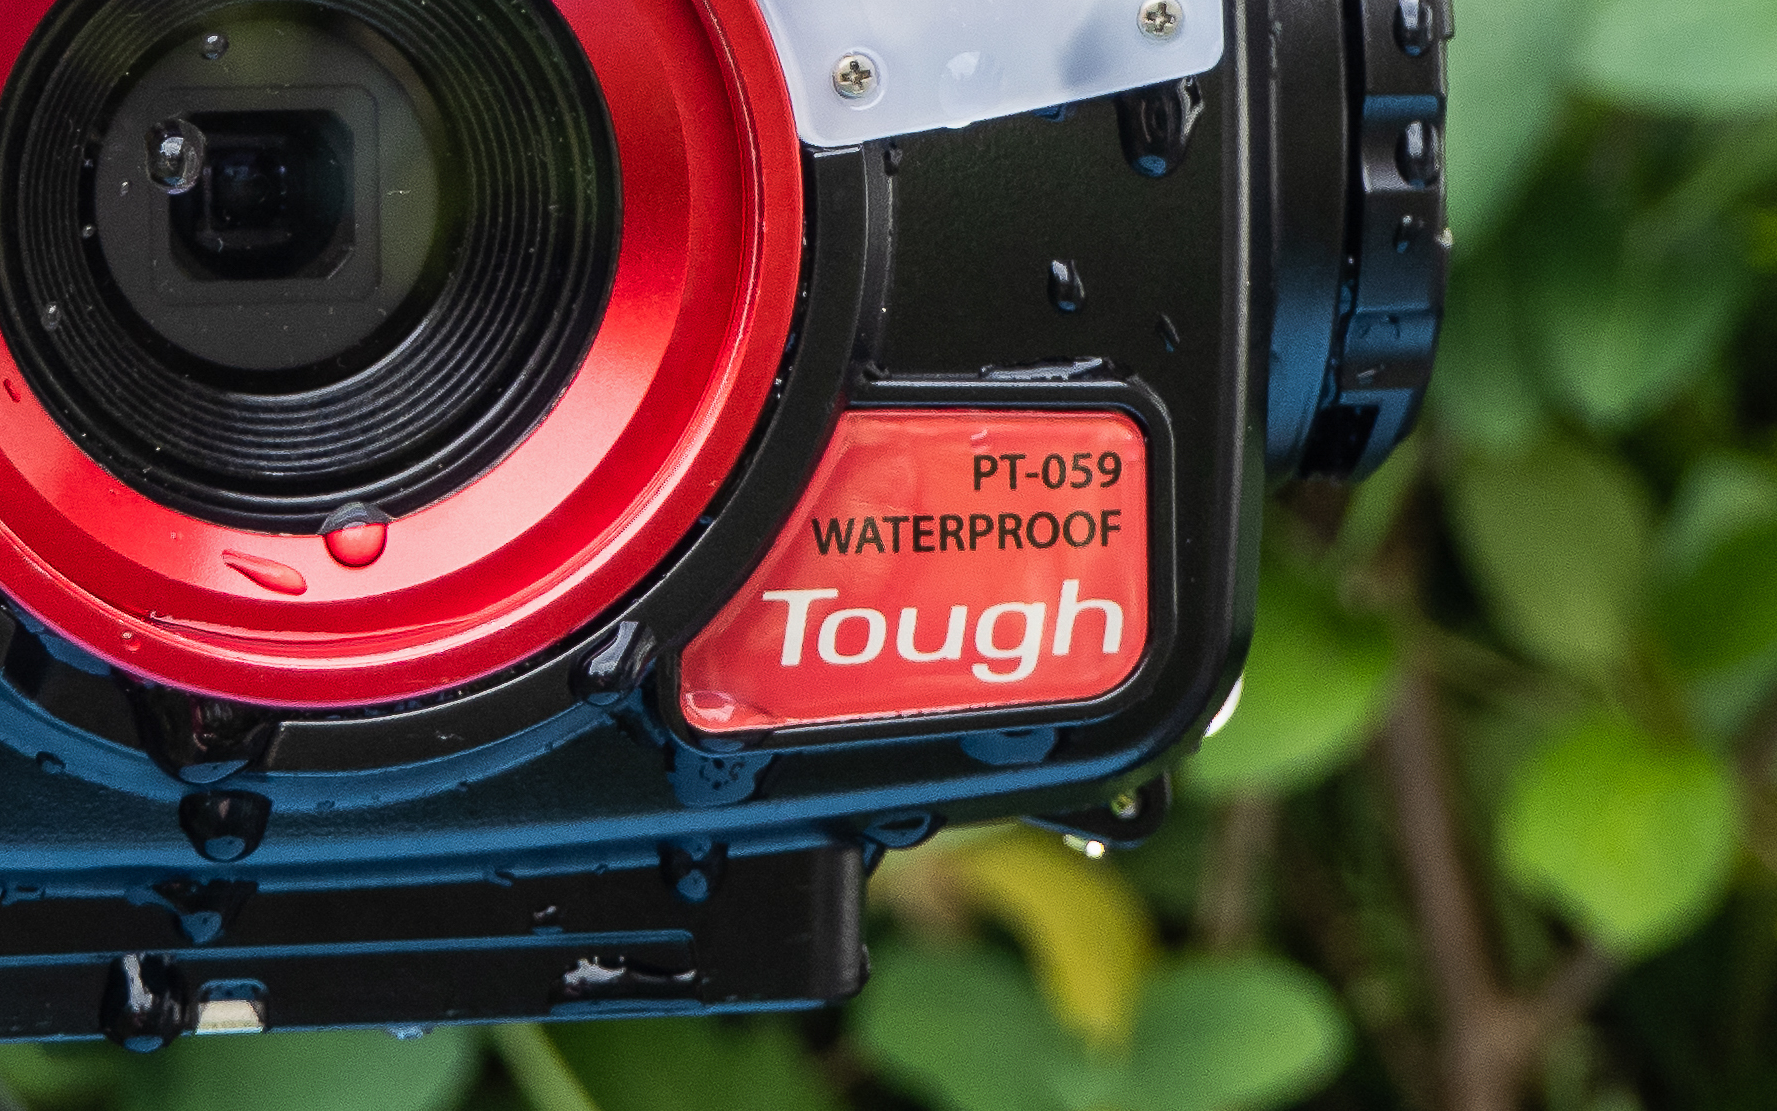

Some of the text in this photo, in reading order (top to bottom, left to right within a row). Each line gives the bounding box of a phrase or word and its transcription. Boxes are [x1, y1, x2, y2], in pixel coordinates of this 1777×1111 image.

[973, 451, 1123, 491] PT-059
[812, 509, 1122, 555] WATERPROOF
[762, 579, 1123, 683] Tough
